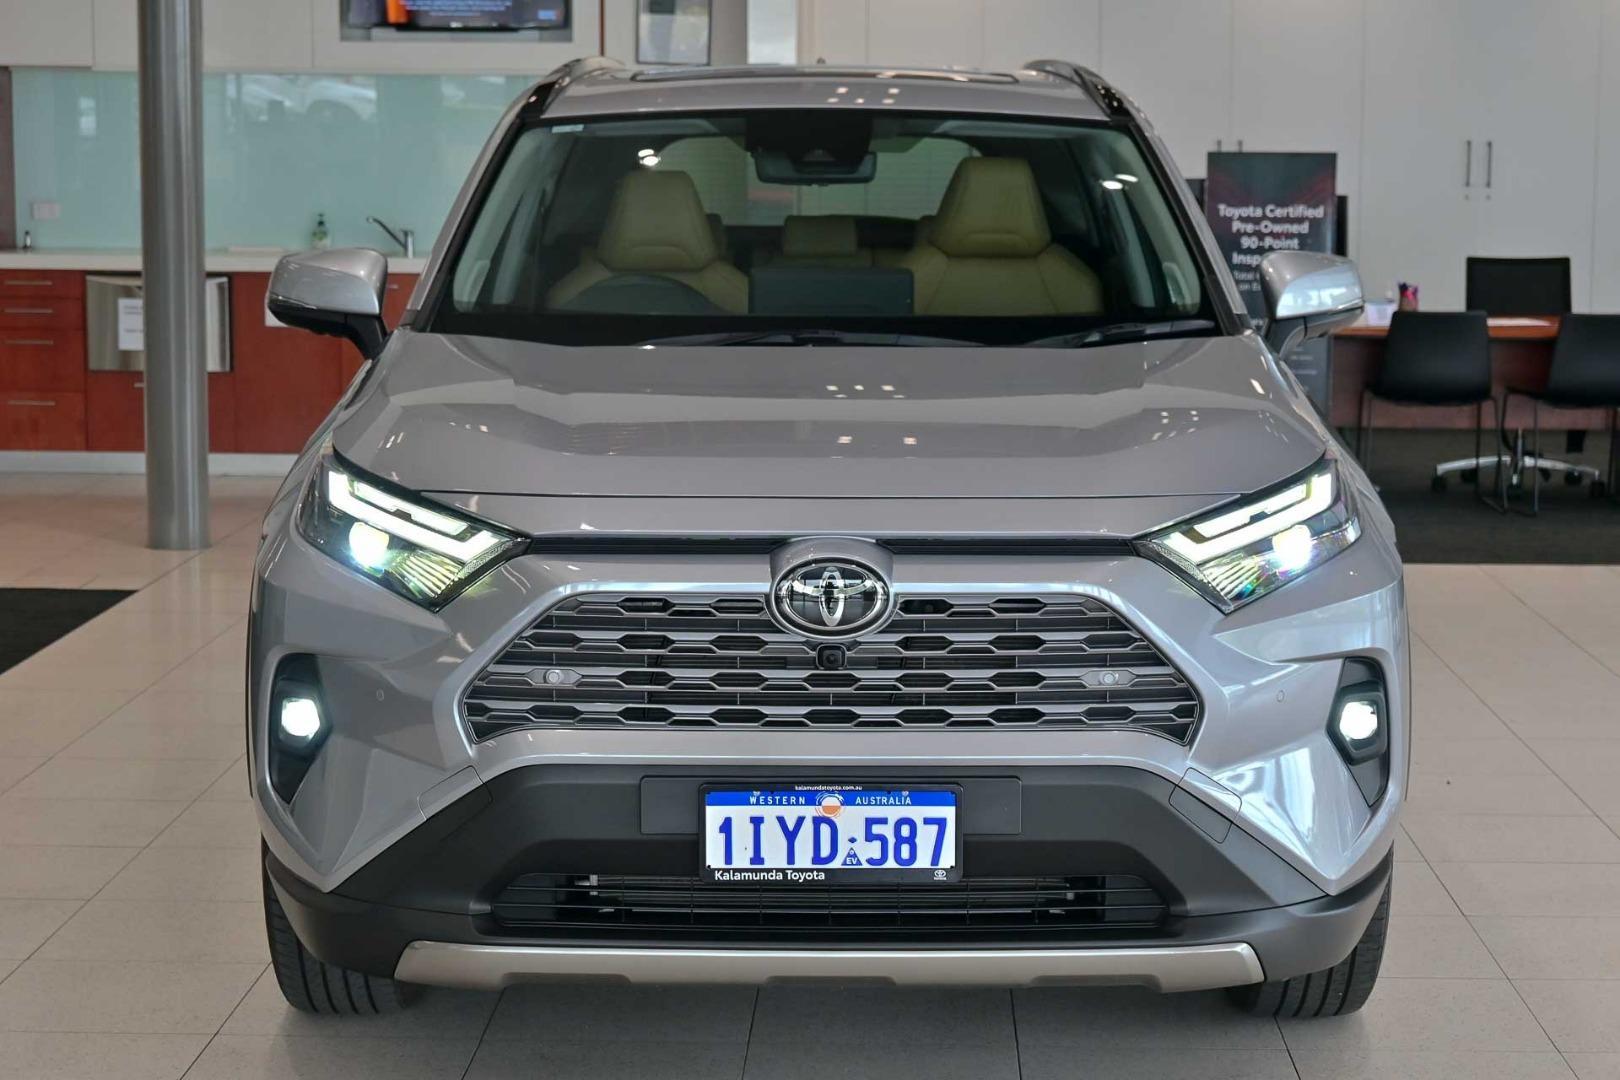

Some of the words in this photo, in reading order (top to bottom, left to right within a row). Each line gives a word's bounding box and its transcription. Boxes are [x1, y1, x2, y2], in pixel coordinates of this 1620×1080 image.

[1218, 204, 1262, 220] Toyota
[1265, 204, 1324, 218] Certified
[1232, 220, 1309, 233] Pre-Owned
[1241, 236, 1299, 249] 90-Point
[750, 797, 806, 805] WESTERN
[855, 797, 912, 806] AUSTRALIA
[714, 870, 783, 881] Kalamunda
[786, 870, 825, 883] Toyota
